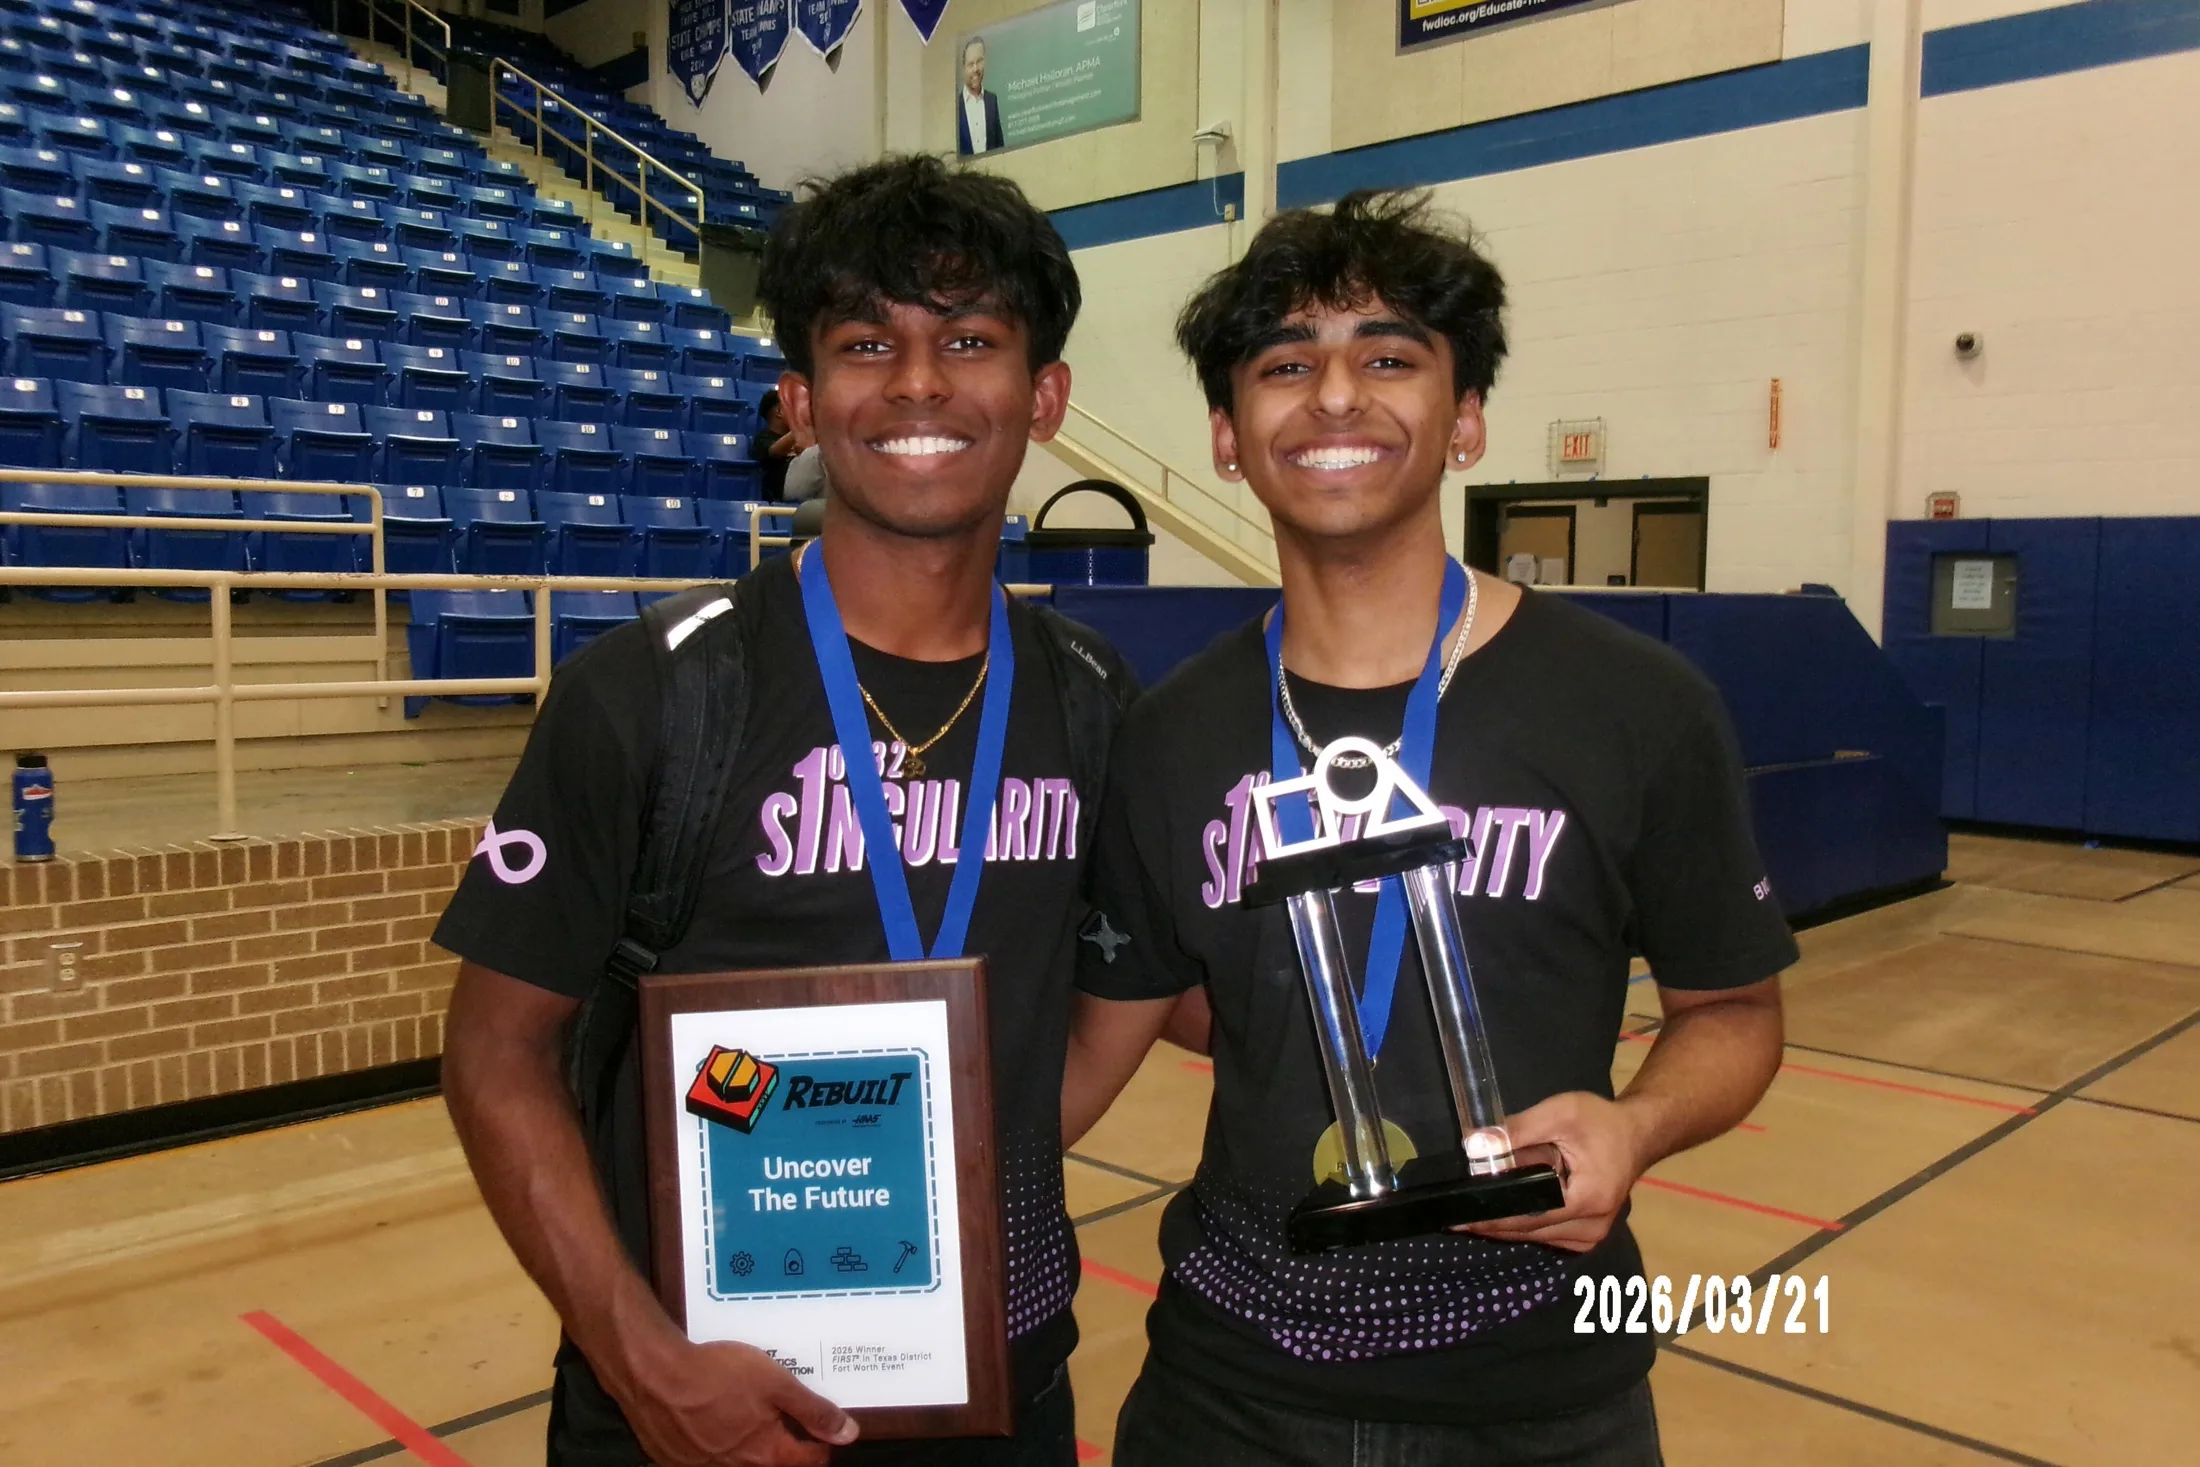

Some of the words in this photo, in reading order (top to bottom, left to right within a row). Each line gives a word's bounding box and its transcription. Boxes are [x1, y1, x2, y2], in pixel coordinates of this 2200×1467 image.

[1008, 76, 1039, 92] Michael
[1075, 56, 1101, 73] APMA
[1563, 433, 1590, 458] EXIT
[1070, 640, 1107, 680] L.L.Bean
[783, 1072, 913, 1111] REBUILT
[764, 1156, 872, 1180] Uncover
[748, 1187, 798, 1212] The
[805, 1186, 890, 1210] Future
[832, 1346, 853, 1355] 2026
[856, 1346, 886, 1354] Winner
[874, 1354, 898, 1362] Texas
[900, 1352, 932, 1361] District
[832, 1364, 850, 1373] Fort
[853, 1364, 878, 1372] Worth
[882, 1362, 905, 1371] Event
